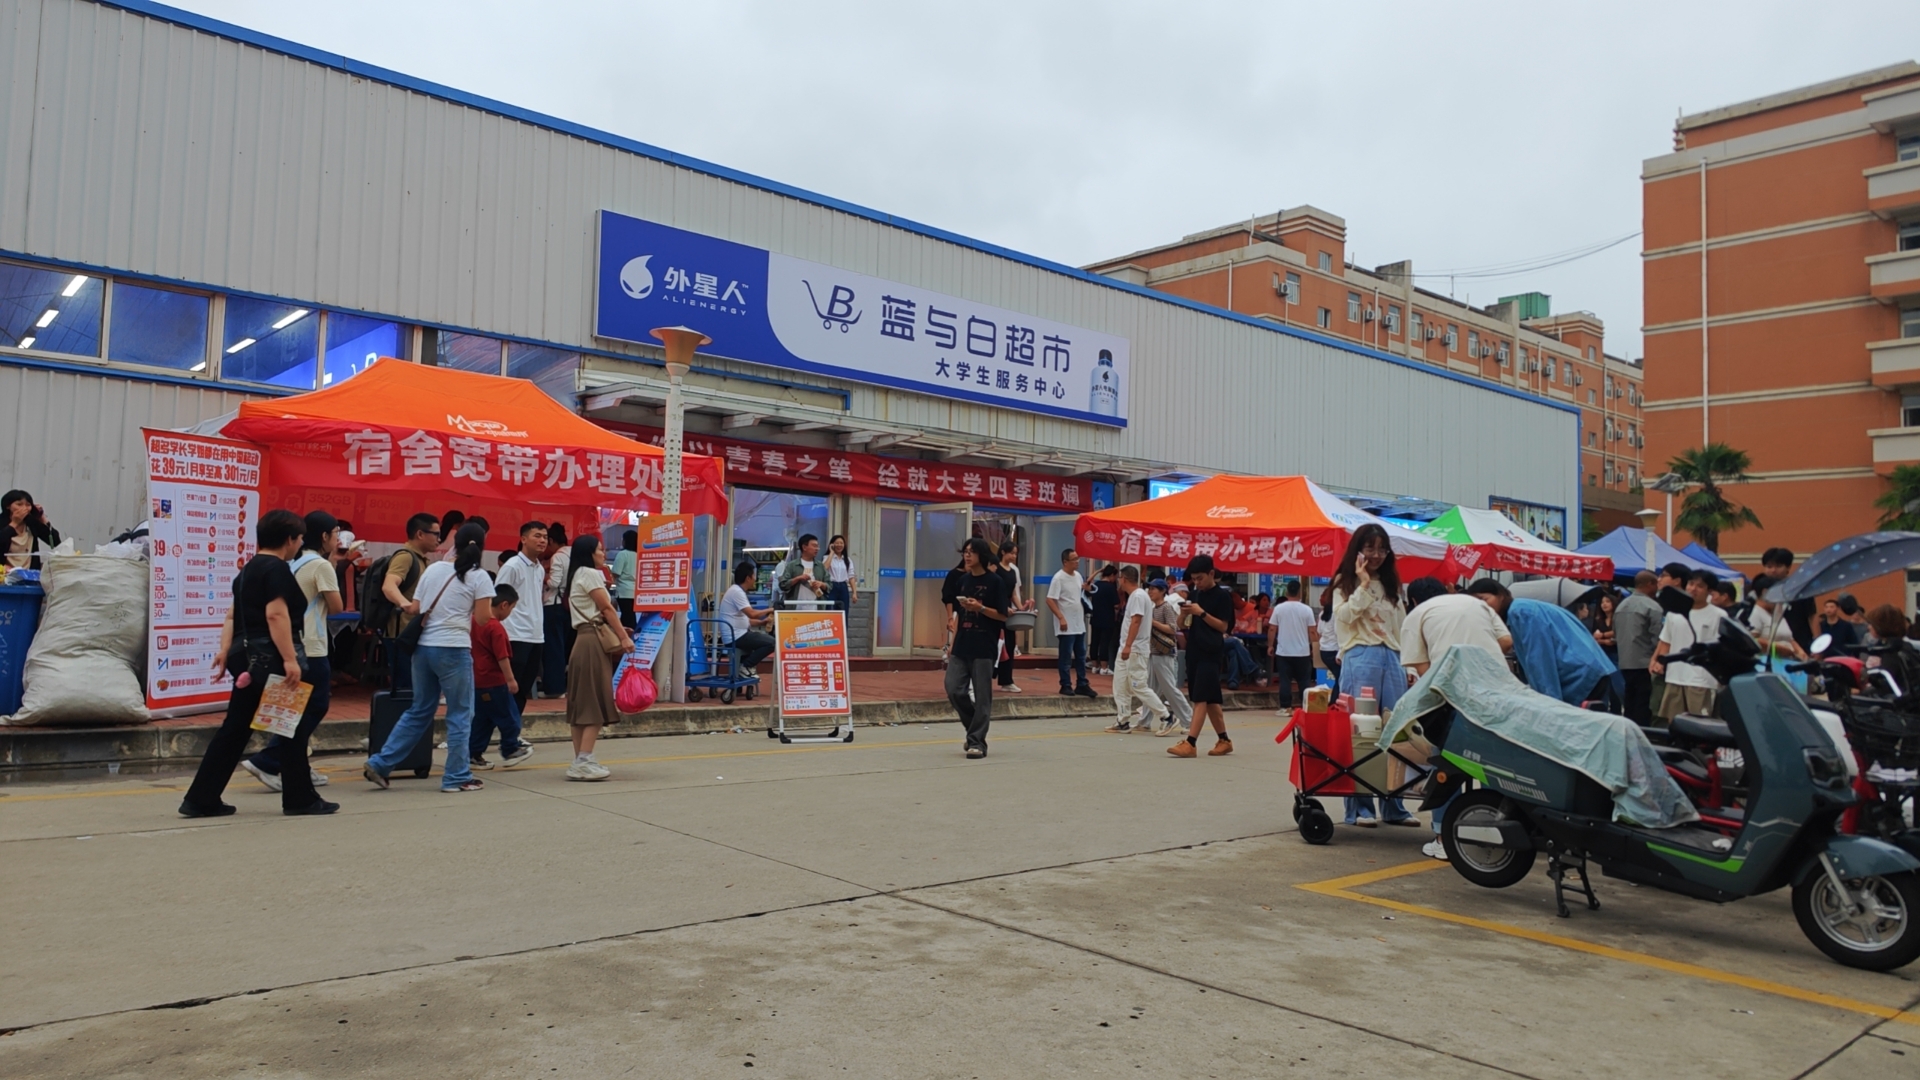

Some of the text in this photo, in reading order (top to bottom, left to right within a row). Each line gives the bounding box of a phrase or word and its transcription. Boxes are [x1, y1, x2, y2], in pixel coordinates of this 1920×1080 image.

[664, 266, 746, 305] 外星人
[662, 295, 747, 316] ALIENERGY
[880, 295, 1071, 373] 蓝与白超市
[935, 357, 1065, 400] 大学生服务中心
[151, 438, 259, 466] 超多学长学姐都在用中国移动
[342, 429, 664, 500] 宿舍宽带办理处
[308, 493, 352, 506] 352GB
[877, 463, 1080, 506] 绘就大学四季斑斓
[1119, 528, 1305, 565] 宿舍宽带办理处
